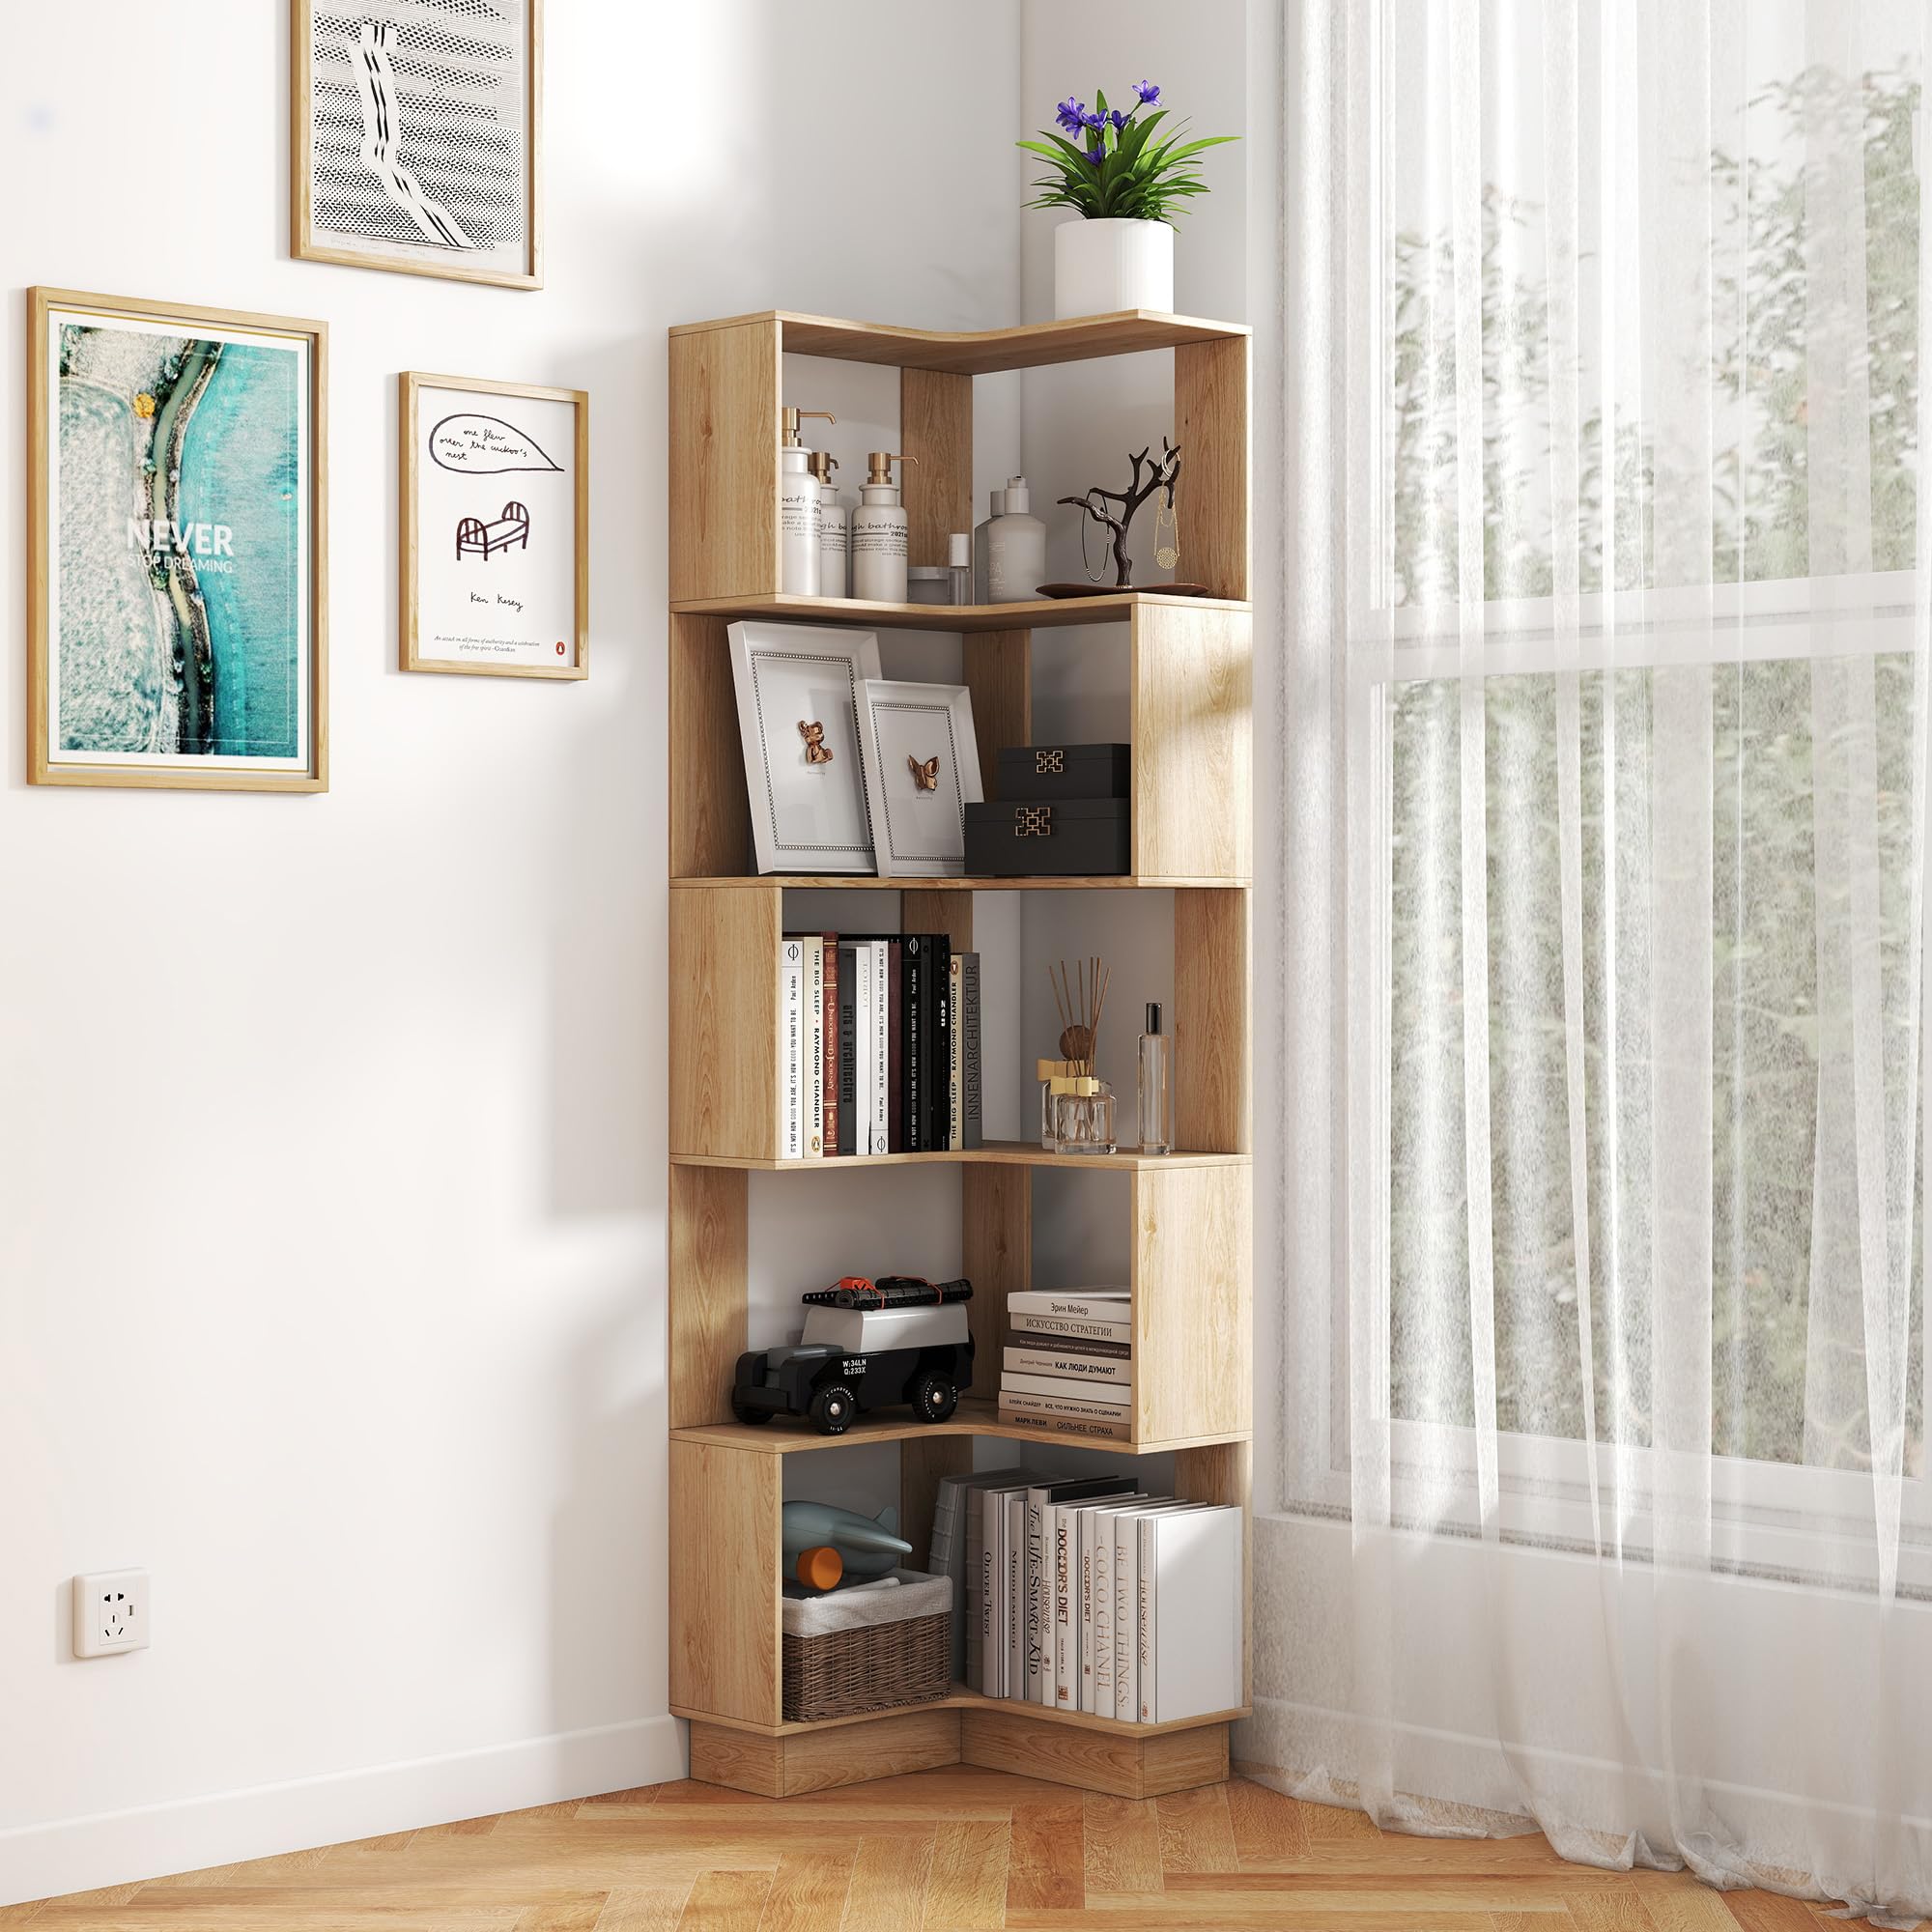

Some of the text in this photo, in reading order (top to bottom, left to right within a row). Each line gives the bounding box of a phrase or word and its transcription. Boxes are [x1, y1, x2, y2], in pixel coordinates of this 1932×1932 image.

[469, 440, 486, 450] the
[483, 429, 505, 441] flew
[445, 451, 468, 460] nest
[127, 518, 234, 556] NEVER
[128, 553, 233, 574] STOP DREAMING
[470, 591, 524, 612] Ken Kesey
[966, 965, 980, 1121] INNENARCHITEKTUR
[843, 1041, 854, 1103] architecture
[1051, 1302, 1089, 1317] Эрин Мейер
[1026, 1318, 1112, 1337] ИСКУССТВО СТРАТЕГИИ
[1054, 1361, 1116, 1376] КАК ЛЮДИ ДУМАЮТ
[1015, 1416, 1047, 1427] МАРК ЛЕВИ
[1057, 1421, 1114, 1436] СИЛЬНЕЕ СТРАХА
[1030, 1504, 1040, 1531] The
[1117, 1545, 1128, 1567] BE
[1117, 1577, 1128, 1621] TWO
[1058, 1596, 1068, 1626] DIET
[1096, 1610, 1110, 1691] CHANEL
